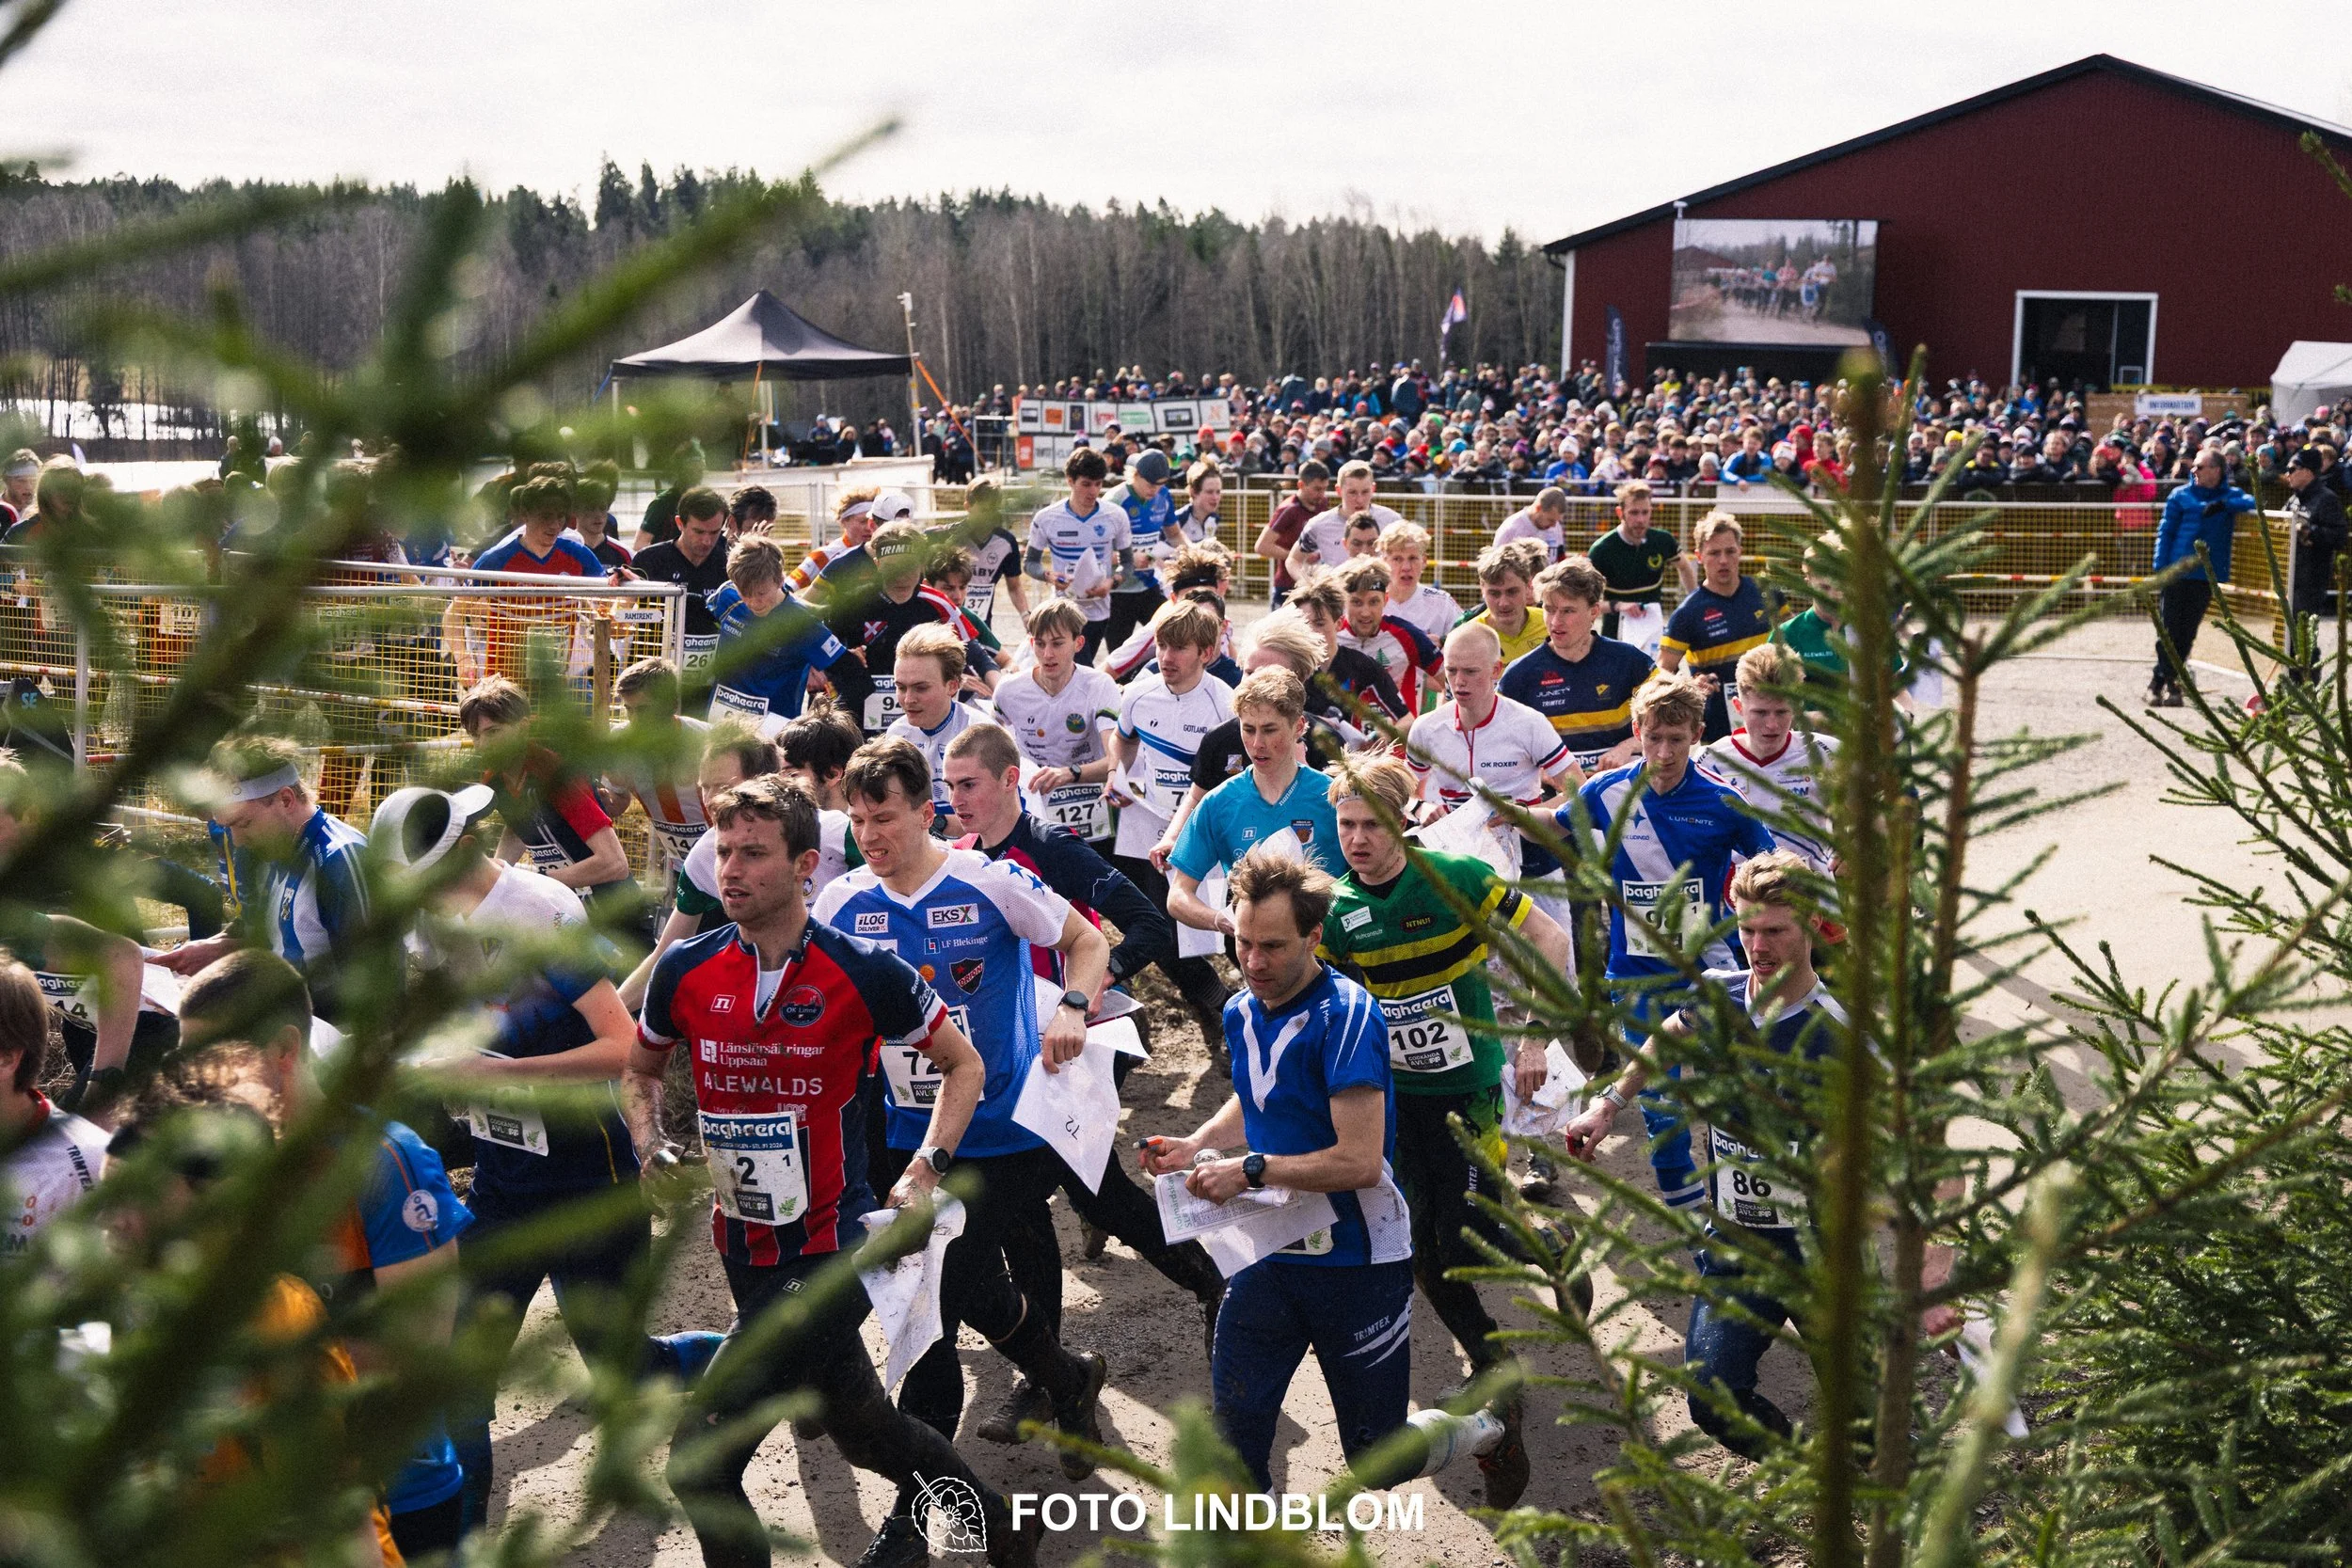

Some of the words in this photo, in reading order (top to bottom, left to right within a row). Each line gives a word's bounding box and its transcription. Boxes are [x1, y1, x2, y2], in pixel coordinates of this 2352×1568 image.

[968, 599, 984, 610] 37
[623, 611, 655, 622] RAMIRENT
[686, 654, 707, 668] 26
[1541, 676, 1564, 686] KVANTUM
[717, 687, 767, 710] bagheera
[1542, 698, 1565, 707] TRIMTEX
[1183, 723, 1208, 734] GOTLAND
[1493, 760, 1518, 768] ROXEN
[1279, 780, 1298, 806] noname
[1055, 801, 1096, 824] 127
[1668, 814, 1714, 827] LUMONITE
[1626, 883, 1699, 900] baghra
[1692, 905, 1697, 914] 1
[858, 914, 886, 926] iLOG
[941, 941, 952, 949] LF
[953, 935, 988, 948] Blekinge
[958, 962, 983, 989] ORION
[1391, 1021, 1449, 1052] 102
[720, 1041, 825, 1059] Länsförsäkringar
[1408, 1051, 1441, 1062] GODKÄNDA
[720, 1055, 768, 1068] Uppsala
[902, 1050, 944, 1077] 72
[704, 1071, 823, 1096] ALEWALDS
[702, 1117, 792, 1140] bagheera
[1065, 1114, 1080, 1141] 72
[770, 1140, 784, 1148] 2026
[782, 1153, 791, 1168] 1
[737, 1156, 759, 1187] 2
[1732, 1169, 1772, 1198] 86
[737, 1193, 769, 1204] GODKÄNDA
[1737, 1202, 1772, 1212] GODKÄNDA
[1353, 1314, 1391, 1342] TRIMTEX
